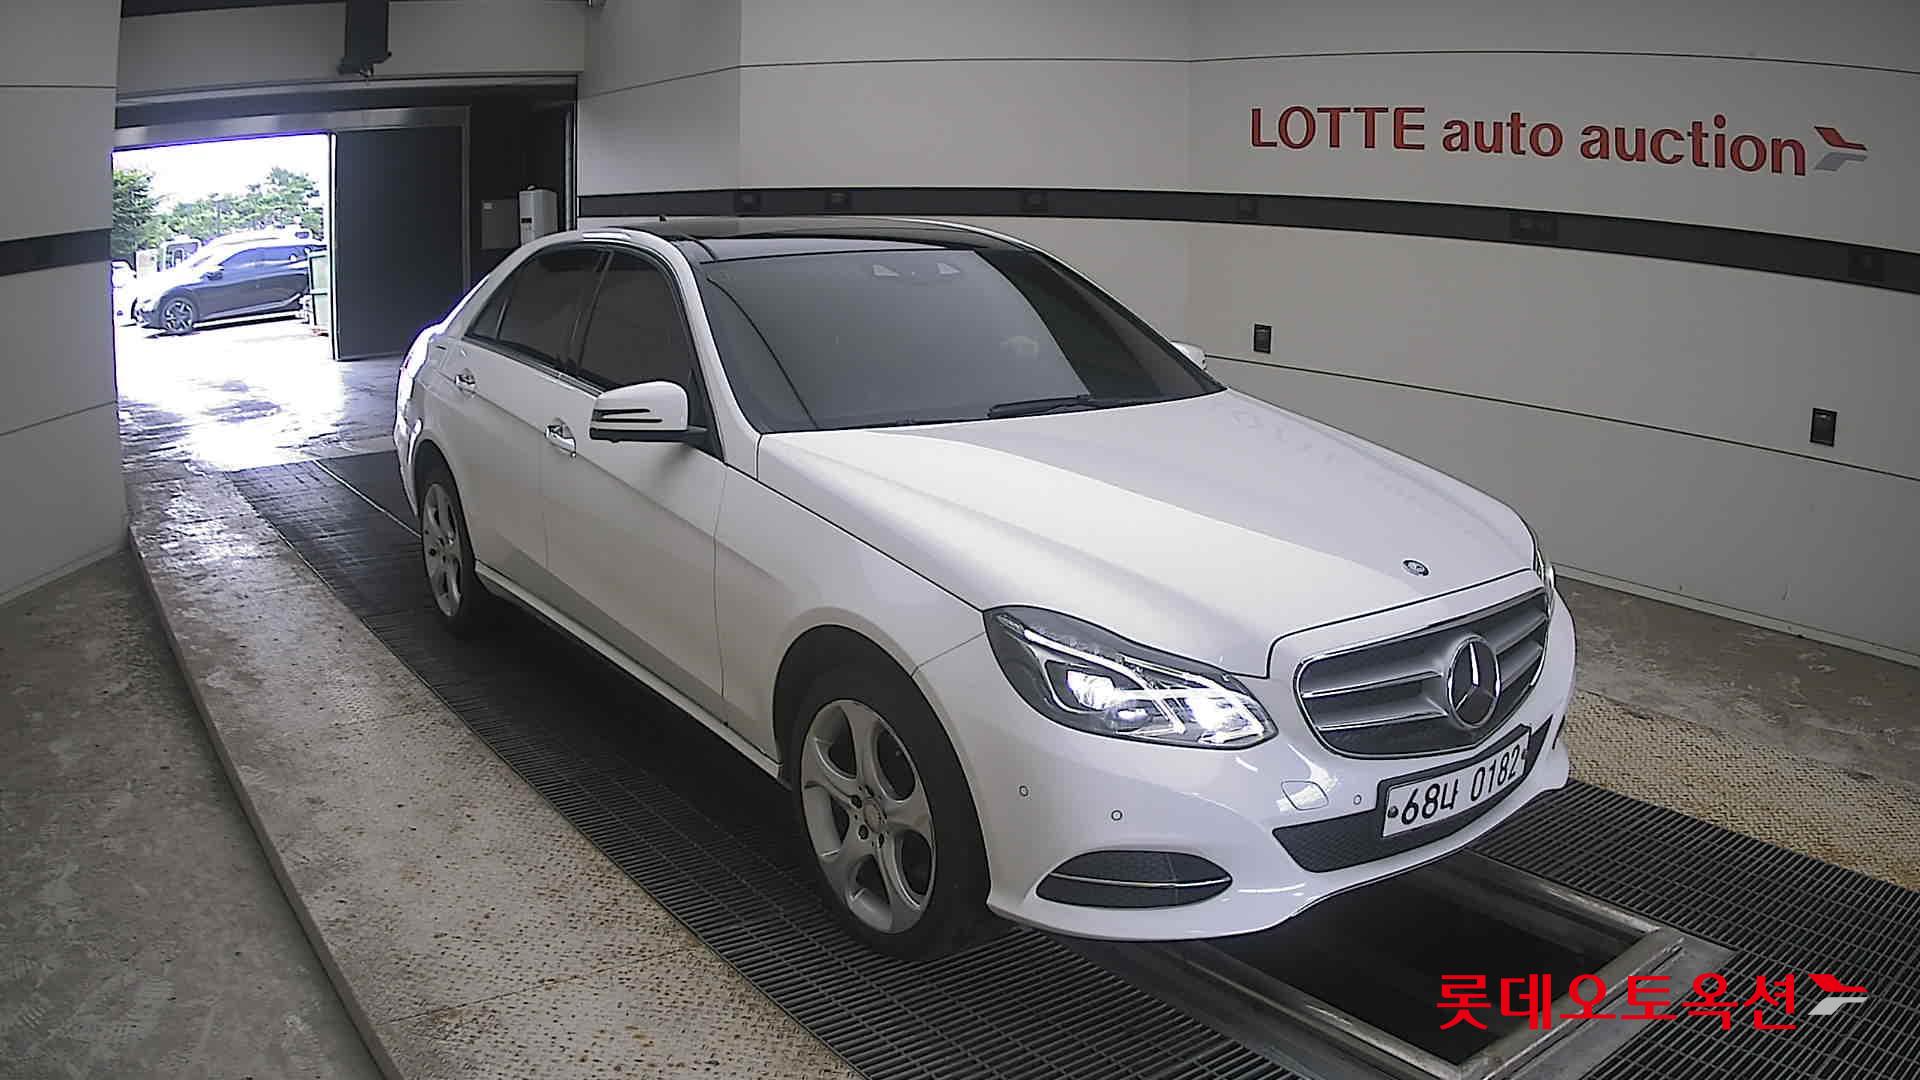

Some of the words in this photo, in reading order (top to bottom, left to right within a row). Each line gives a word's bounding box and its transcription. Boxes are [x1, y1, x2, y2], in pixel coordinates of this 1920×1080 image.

[1250, 106, 1426, 151] LOTTE
[1442, 112, 1564, 157] auto
[1579, 114, 1807, 177] auction
[1401, 778, 1459, 825] 68나
[1470, 744, 1521, 801] 0182
